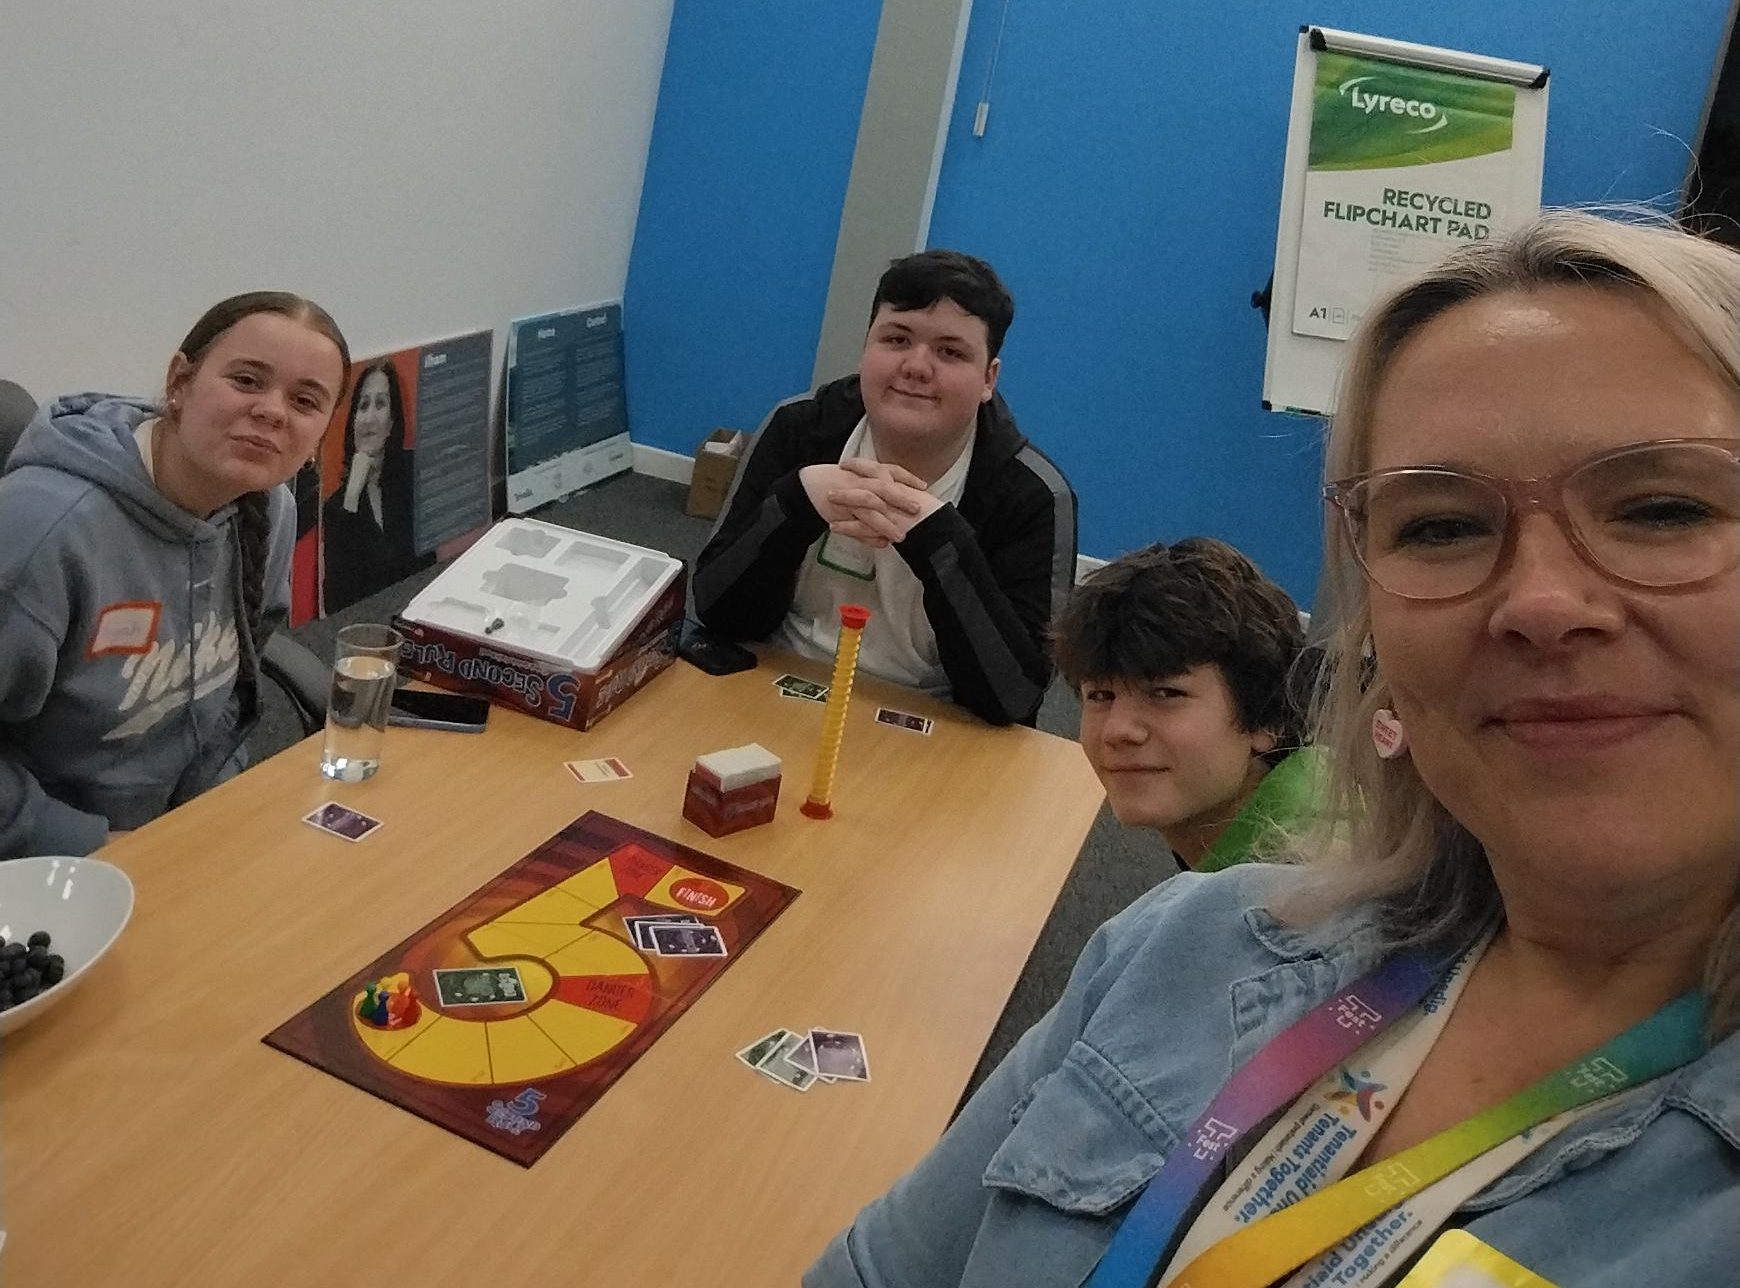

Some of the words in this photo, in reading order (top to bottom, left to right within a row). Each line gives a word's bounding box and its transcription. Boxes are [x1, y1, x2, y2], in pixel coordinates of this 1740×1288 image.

[1351, 86, 1437, 121] Lyreco
[1323, 200, 1442, 236] FLIPCHART
[1446, 218, 1490, 242] PAD
[1382, 187, 1492, 220] RECYCLED
[1309, 307, 1327, 319] A1
[548, 671, 581, 722] 5
[676, 886, 718, 908] FINISH
[1292, 1111, 1340, 1159] Tenants
